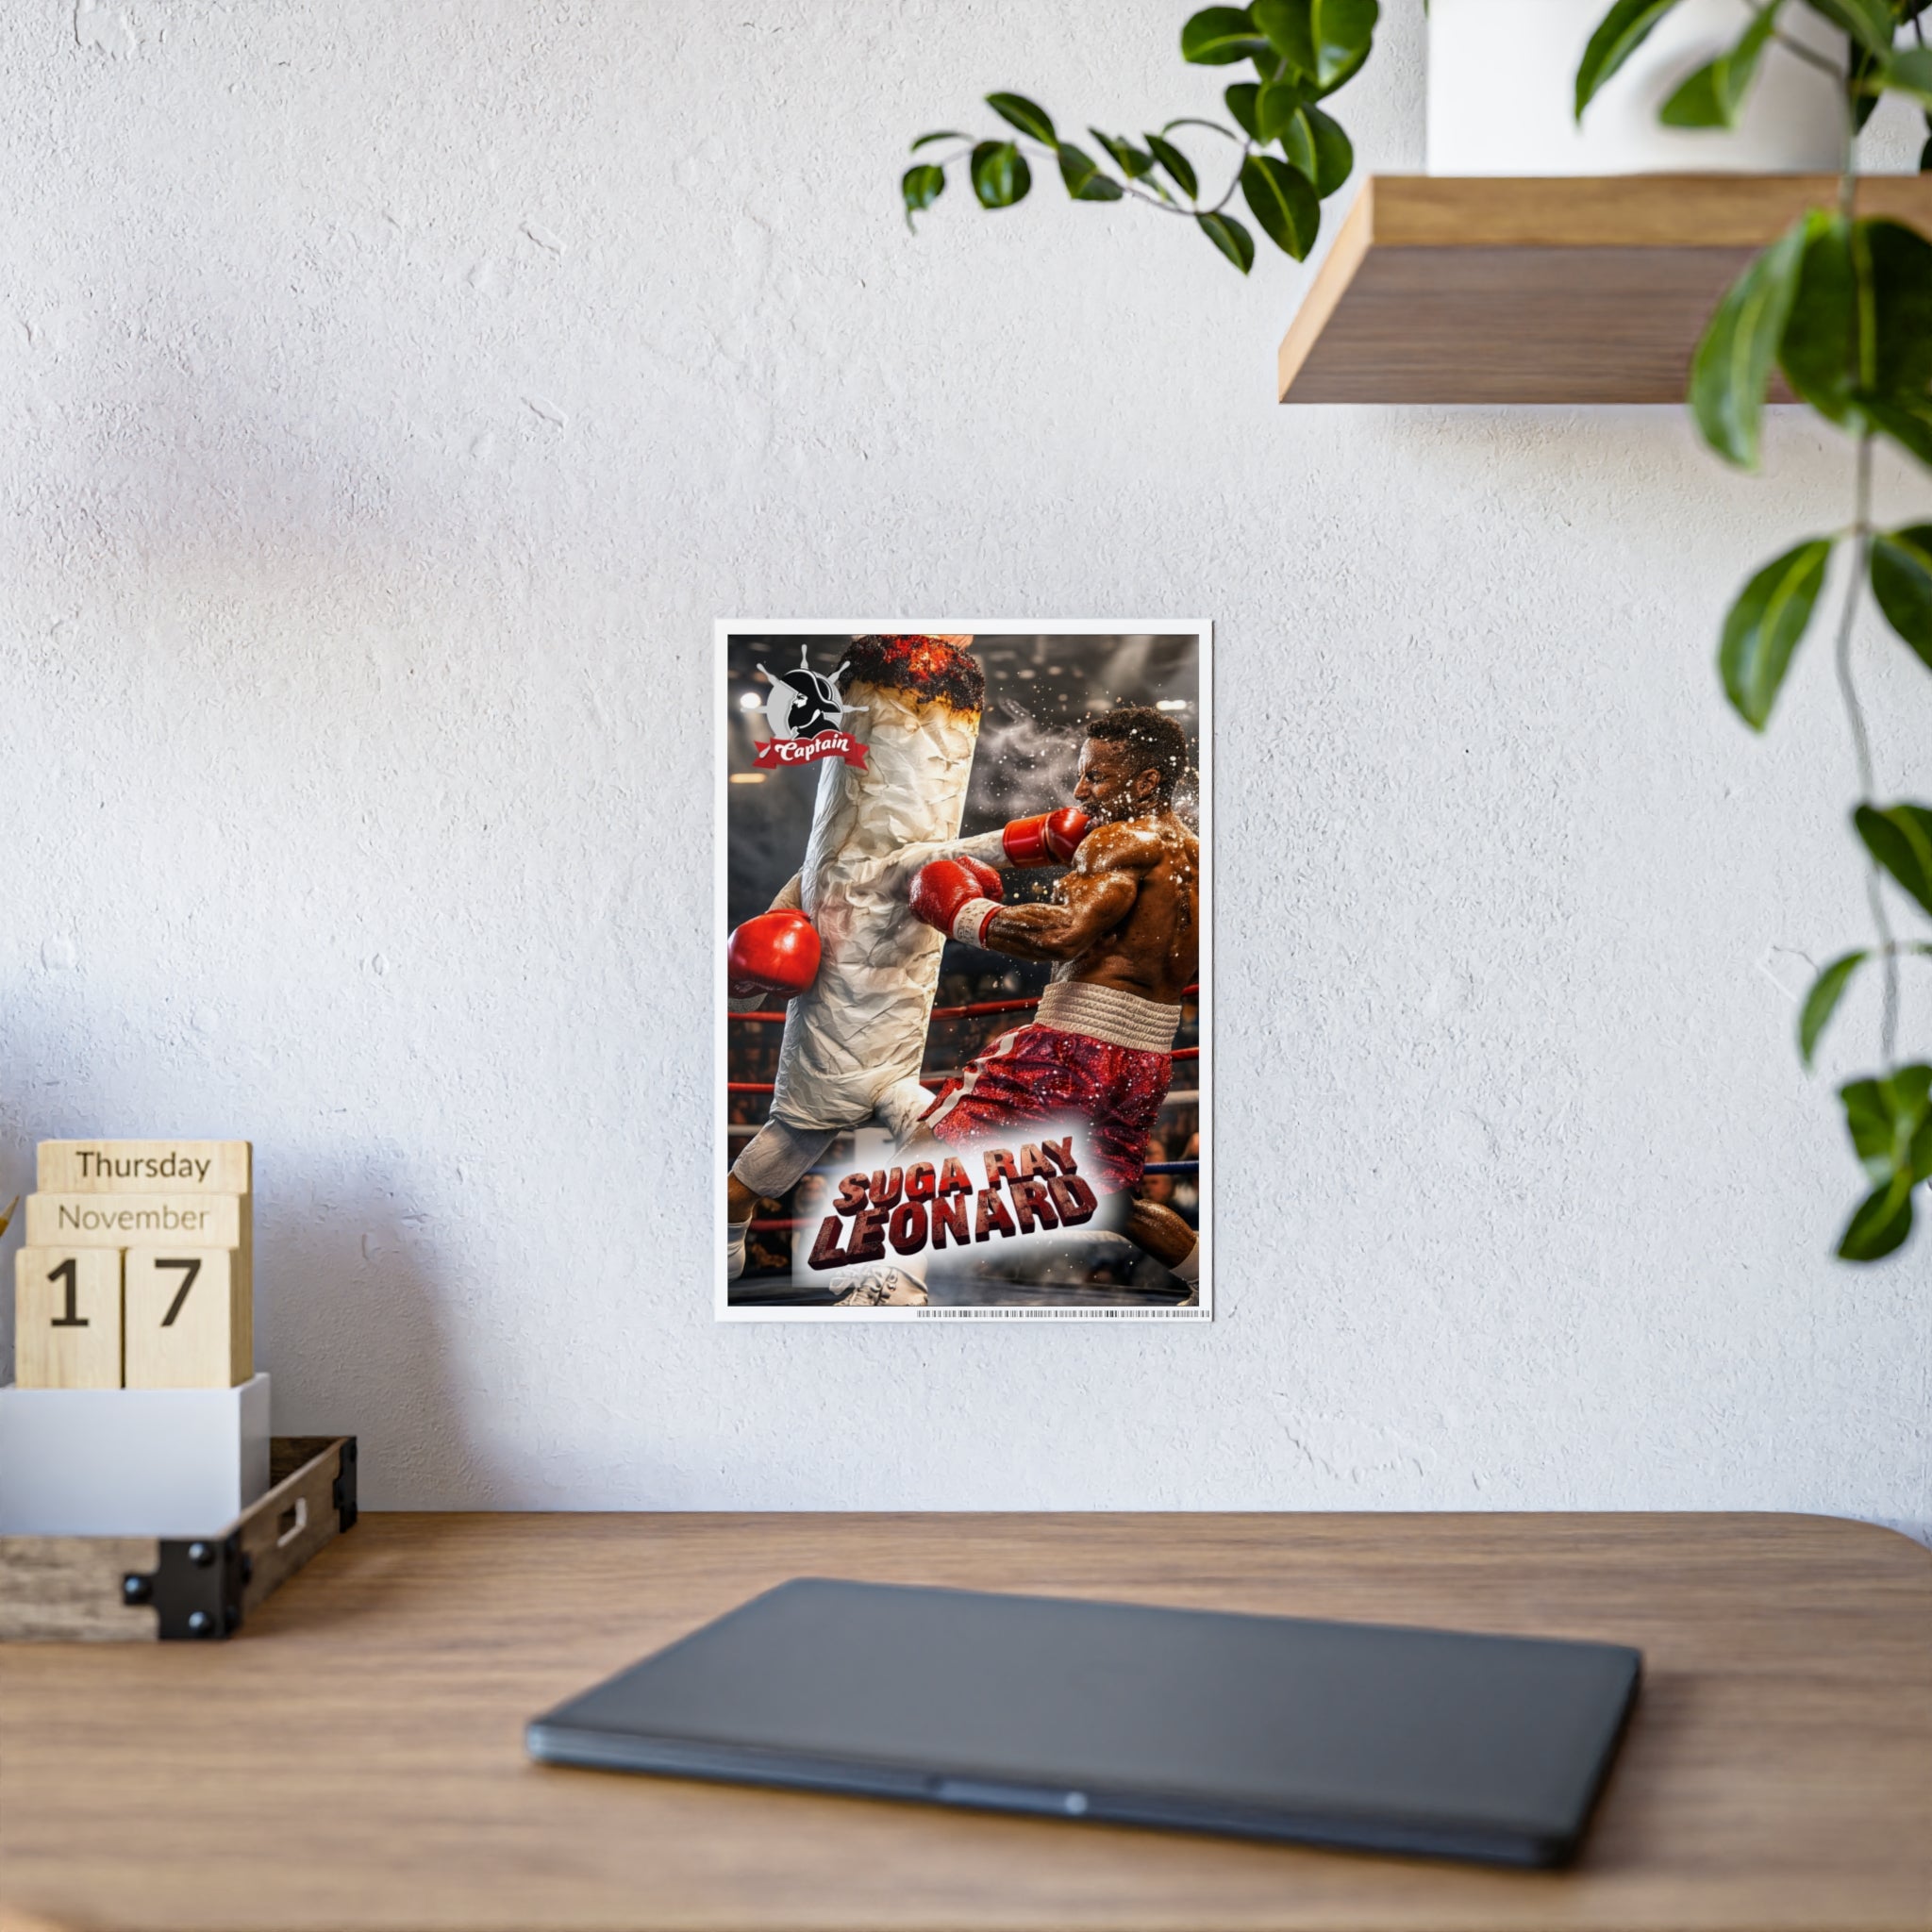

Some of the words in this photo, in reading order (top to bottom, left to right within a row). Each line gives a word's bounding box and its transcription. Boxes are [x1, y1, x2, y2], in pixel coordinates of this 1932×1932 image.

[774, 733, 849, 761] Captain
[75, 1151, 210, 1183] Thursday
[832, 1157, 973, 1216] SUGA
[983, 1136, 1077, 1191] RAY
[58, 1204, 209, 1230] November
[808, 1174, 1098, 1271] LEONARD
